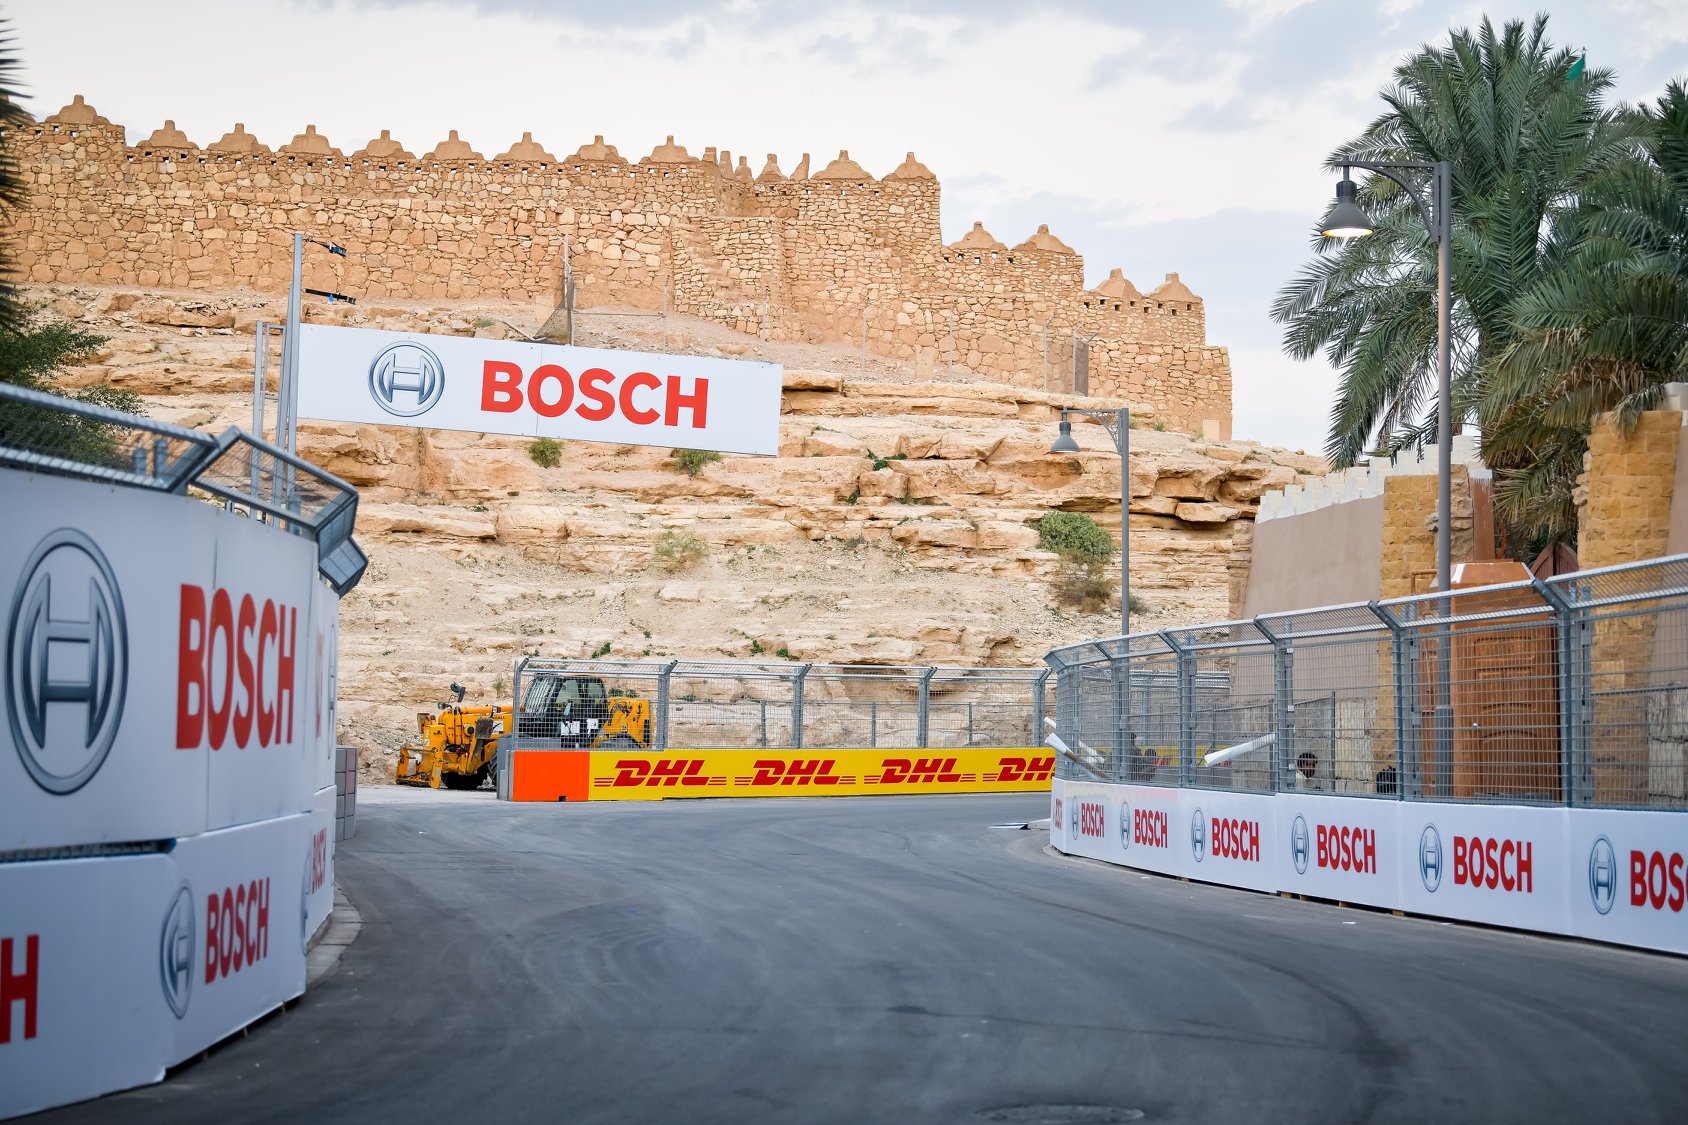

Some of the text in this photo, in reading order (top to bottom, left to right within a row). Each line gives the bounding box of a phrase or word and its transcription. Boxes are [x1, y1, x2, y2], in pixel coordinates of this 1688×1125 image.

[481, 360, 709, 429] BOSCH
[176, 583, 297, 751] BOSCH
[613, 759, 710, 787] DHL
[752, 759, 840, 786] DHL
[879, 758, 962, 785] DHL
[997, 757, 1055, 781] DH
[1081, 802, 1105, 838] BOSCH
[1134, 808, 1168, 848] BOSCH
[1211, 817, 1260, 862] BOSCH
[1317, 824, 1377, 875] BOSCH
[1453, 836, 1533, 893] BOSCH
[1630, 850, 1688, 913] BOS
[204, 877, 270, 984] BOSCH
